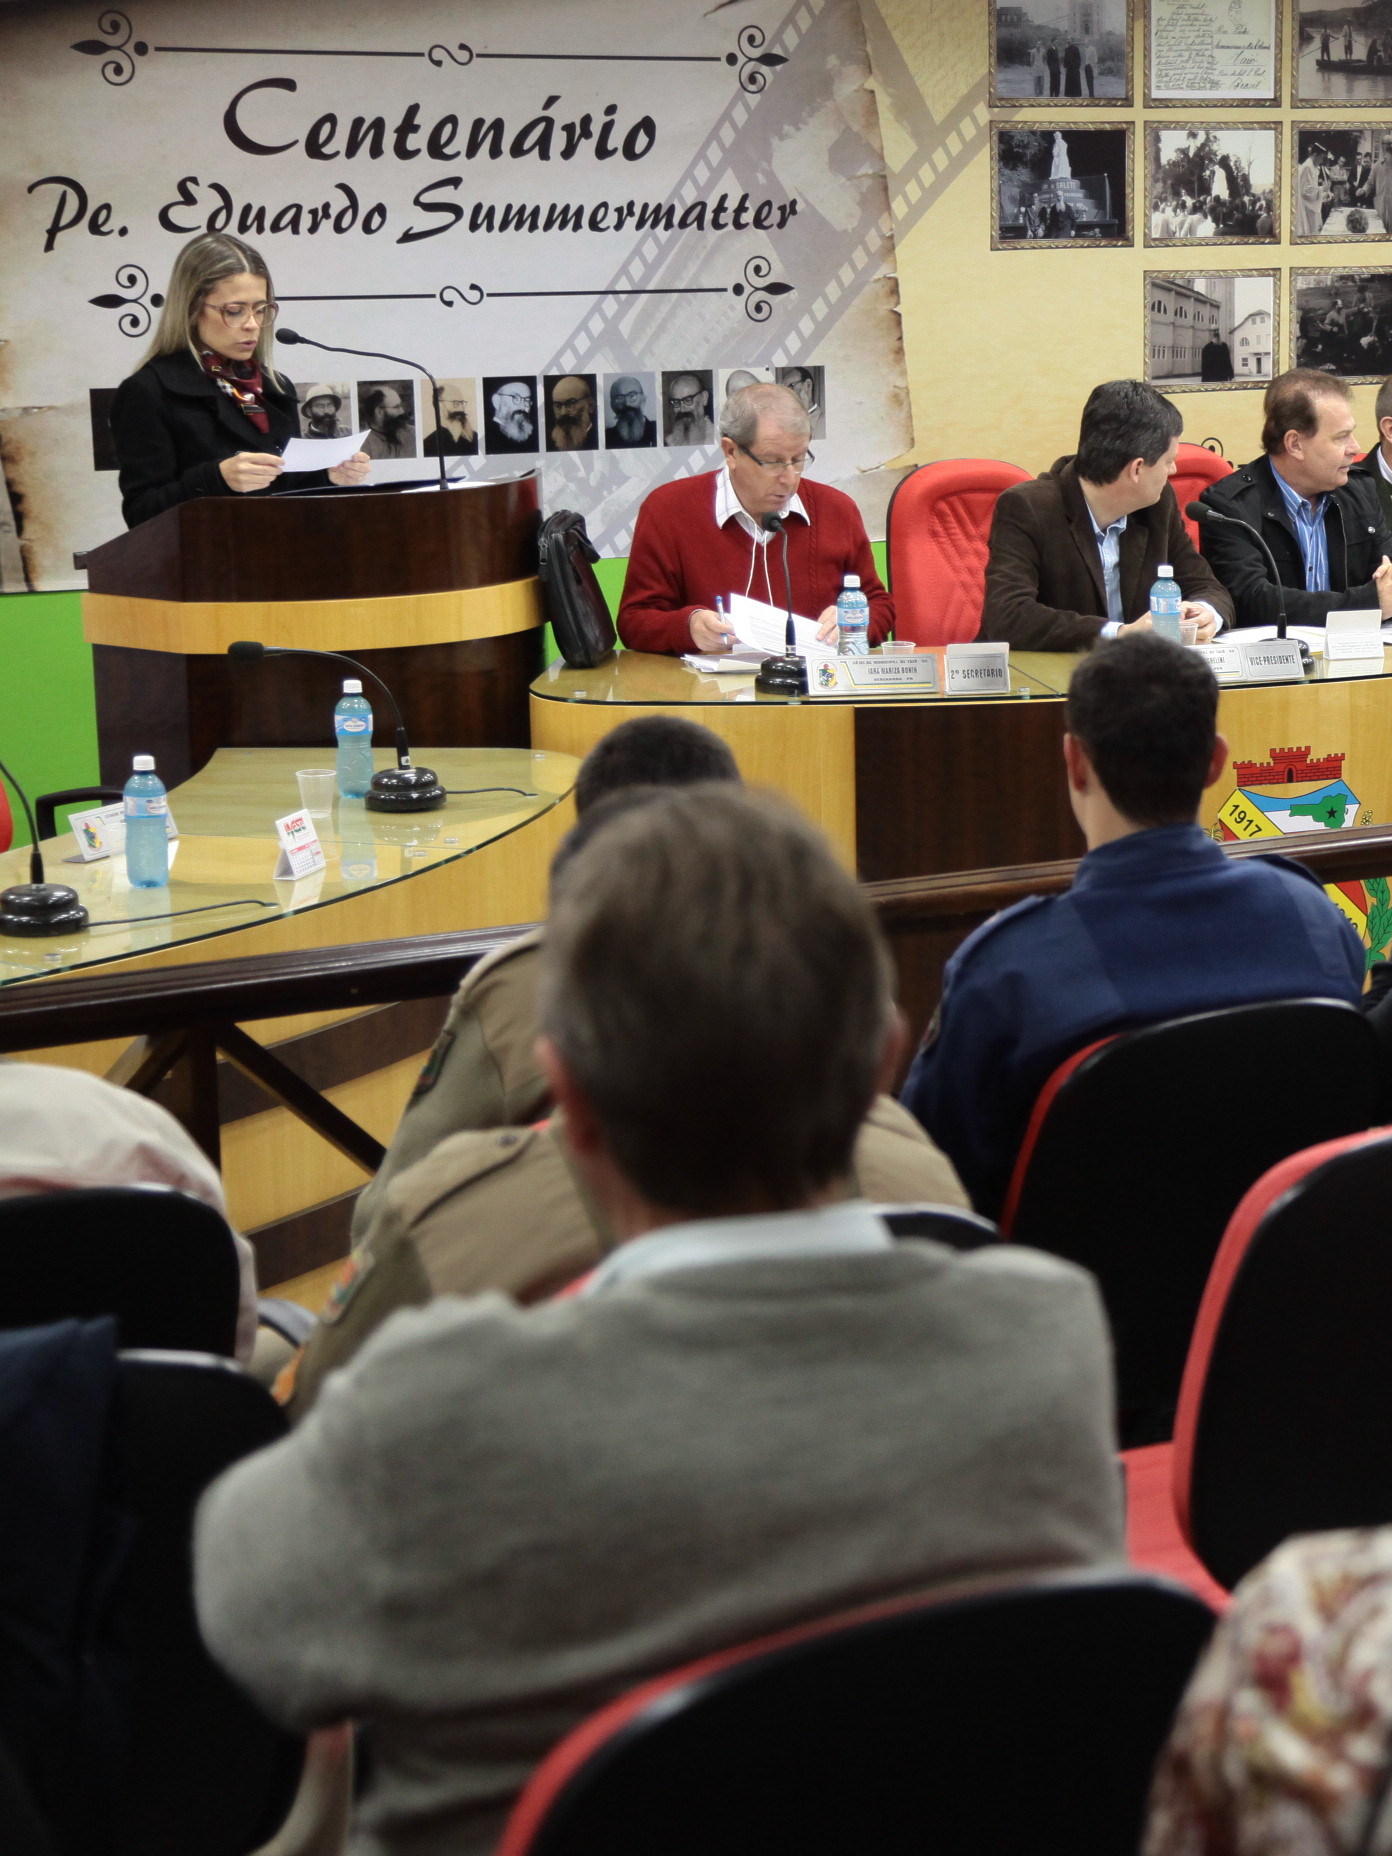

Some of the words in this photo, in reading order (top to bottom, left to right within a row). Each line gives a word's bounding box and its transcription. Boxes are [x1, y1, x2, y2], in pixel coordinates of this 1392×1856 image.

[223, 77, 657, 161] Centenário
[27, 176, 128, 253] Pe.
[158, 176, 387, 236] Eduardo
[396, 176, 799, 245] Summermatter
[962, 665, 1003, 679] SECRETÁRIO
[1249, 654, 1296, 667] VICE-PRESIDENTE
[1228, 804, 1263, 837] 1917
